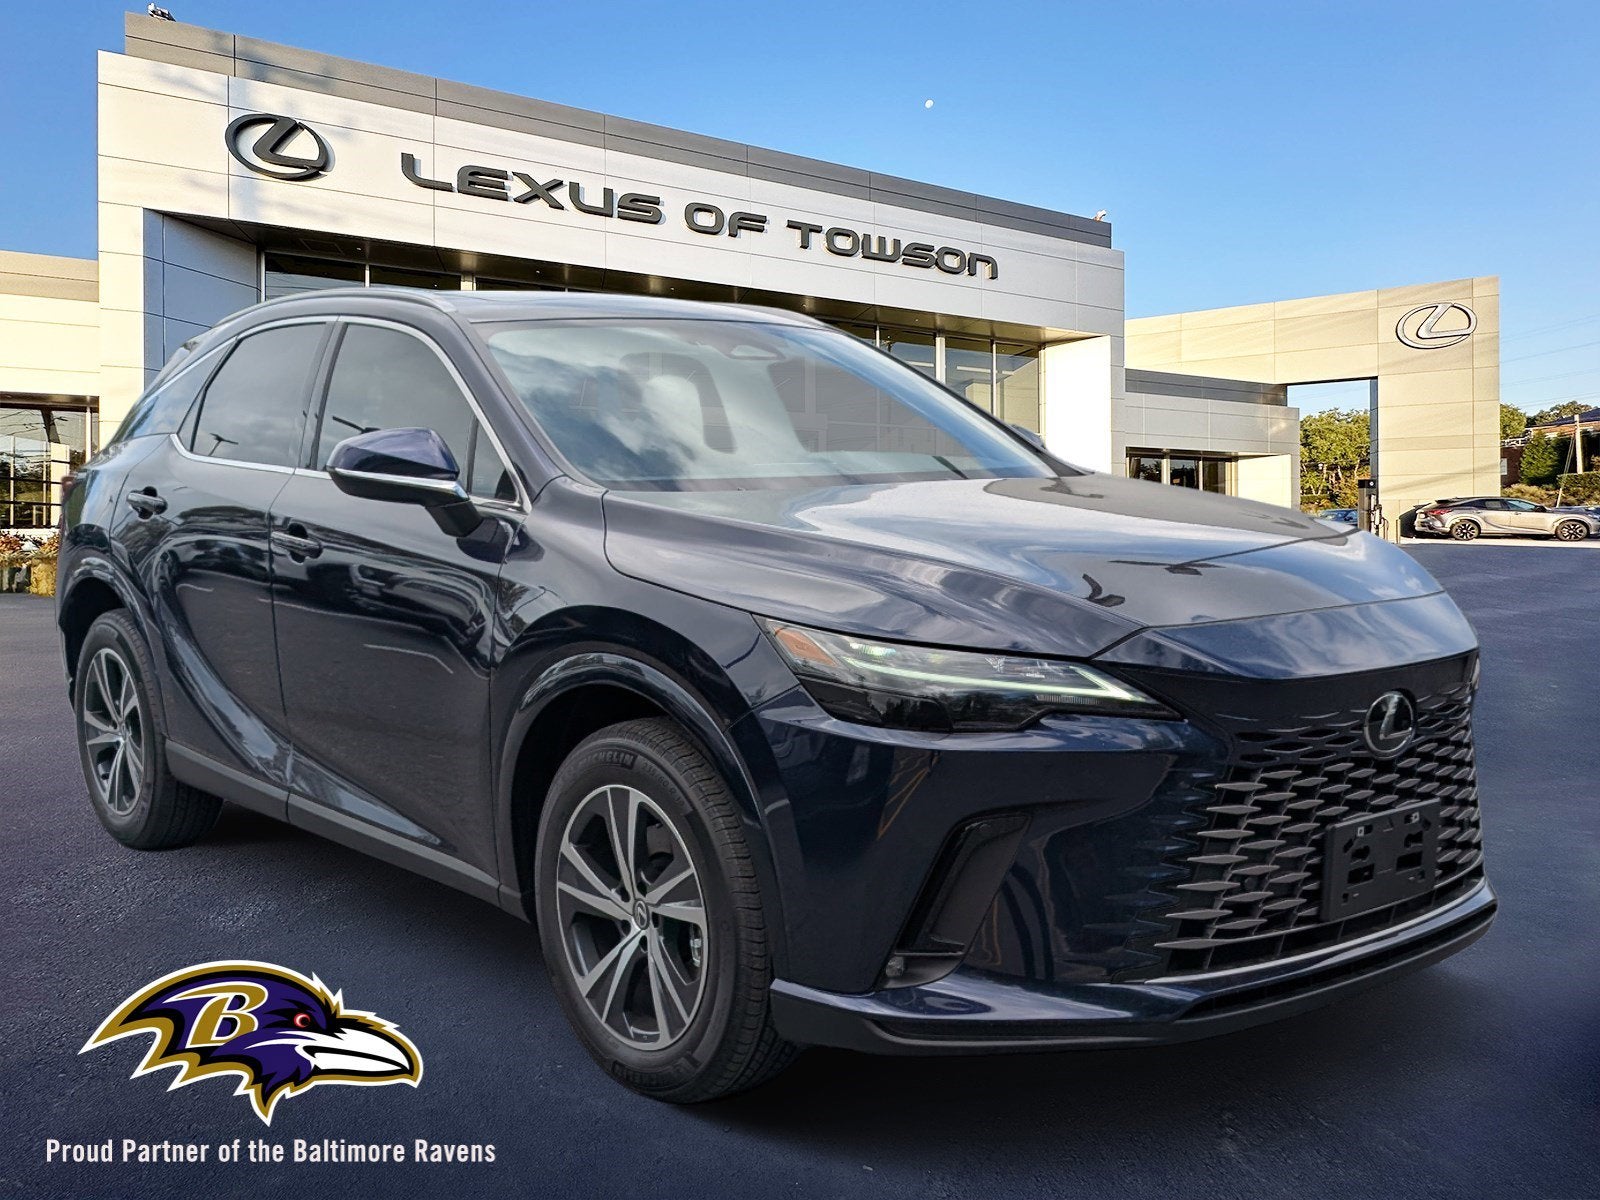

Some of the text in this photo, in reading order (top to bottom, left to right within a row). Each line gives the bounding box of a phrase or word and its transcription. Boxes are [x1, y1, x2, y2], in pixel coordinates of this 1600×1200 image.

[401, 152, 999, 280] LEXUS OF TOWSON
